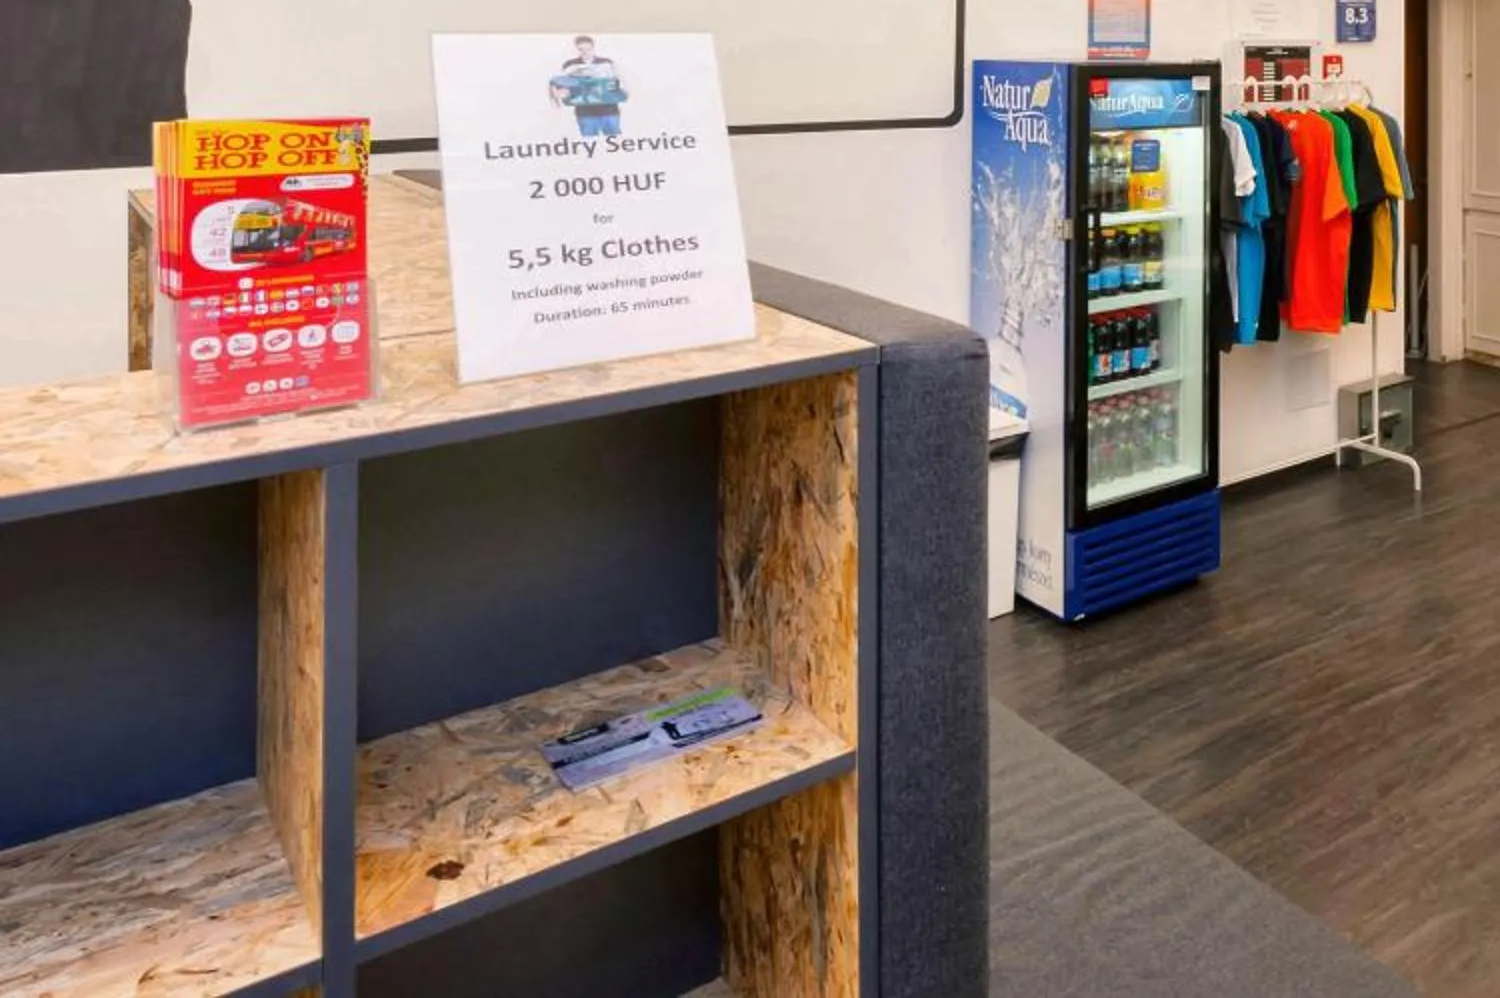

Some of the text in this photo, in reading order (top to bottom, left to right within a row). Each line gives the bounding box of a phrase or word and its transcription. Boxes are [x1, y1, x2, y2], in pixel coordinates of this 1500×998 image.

[1345, 8, 1369, 24] 8.3
[982, 74, 1030, 111] Natur
[196, 132, 334, 152] HOP ON
[1003, 108, 1052, 152] Aqua
[194, 149, 338, 170] HOP OFF
[484, 132, 697, 160] Laundry Service
[529, 172, 666, 199] 2 000 HUF
[593, 212, 615, 225] for
[508, 234, 699, 272] 5,5 kg Clothes
[511, 269, 704, 300] Including washing powder
[534, 293, 691, 324] Duration: 65 minutes
